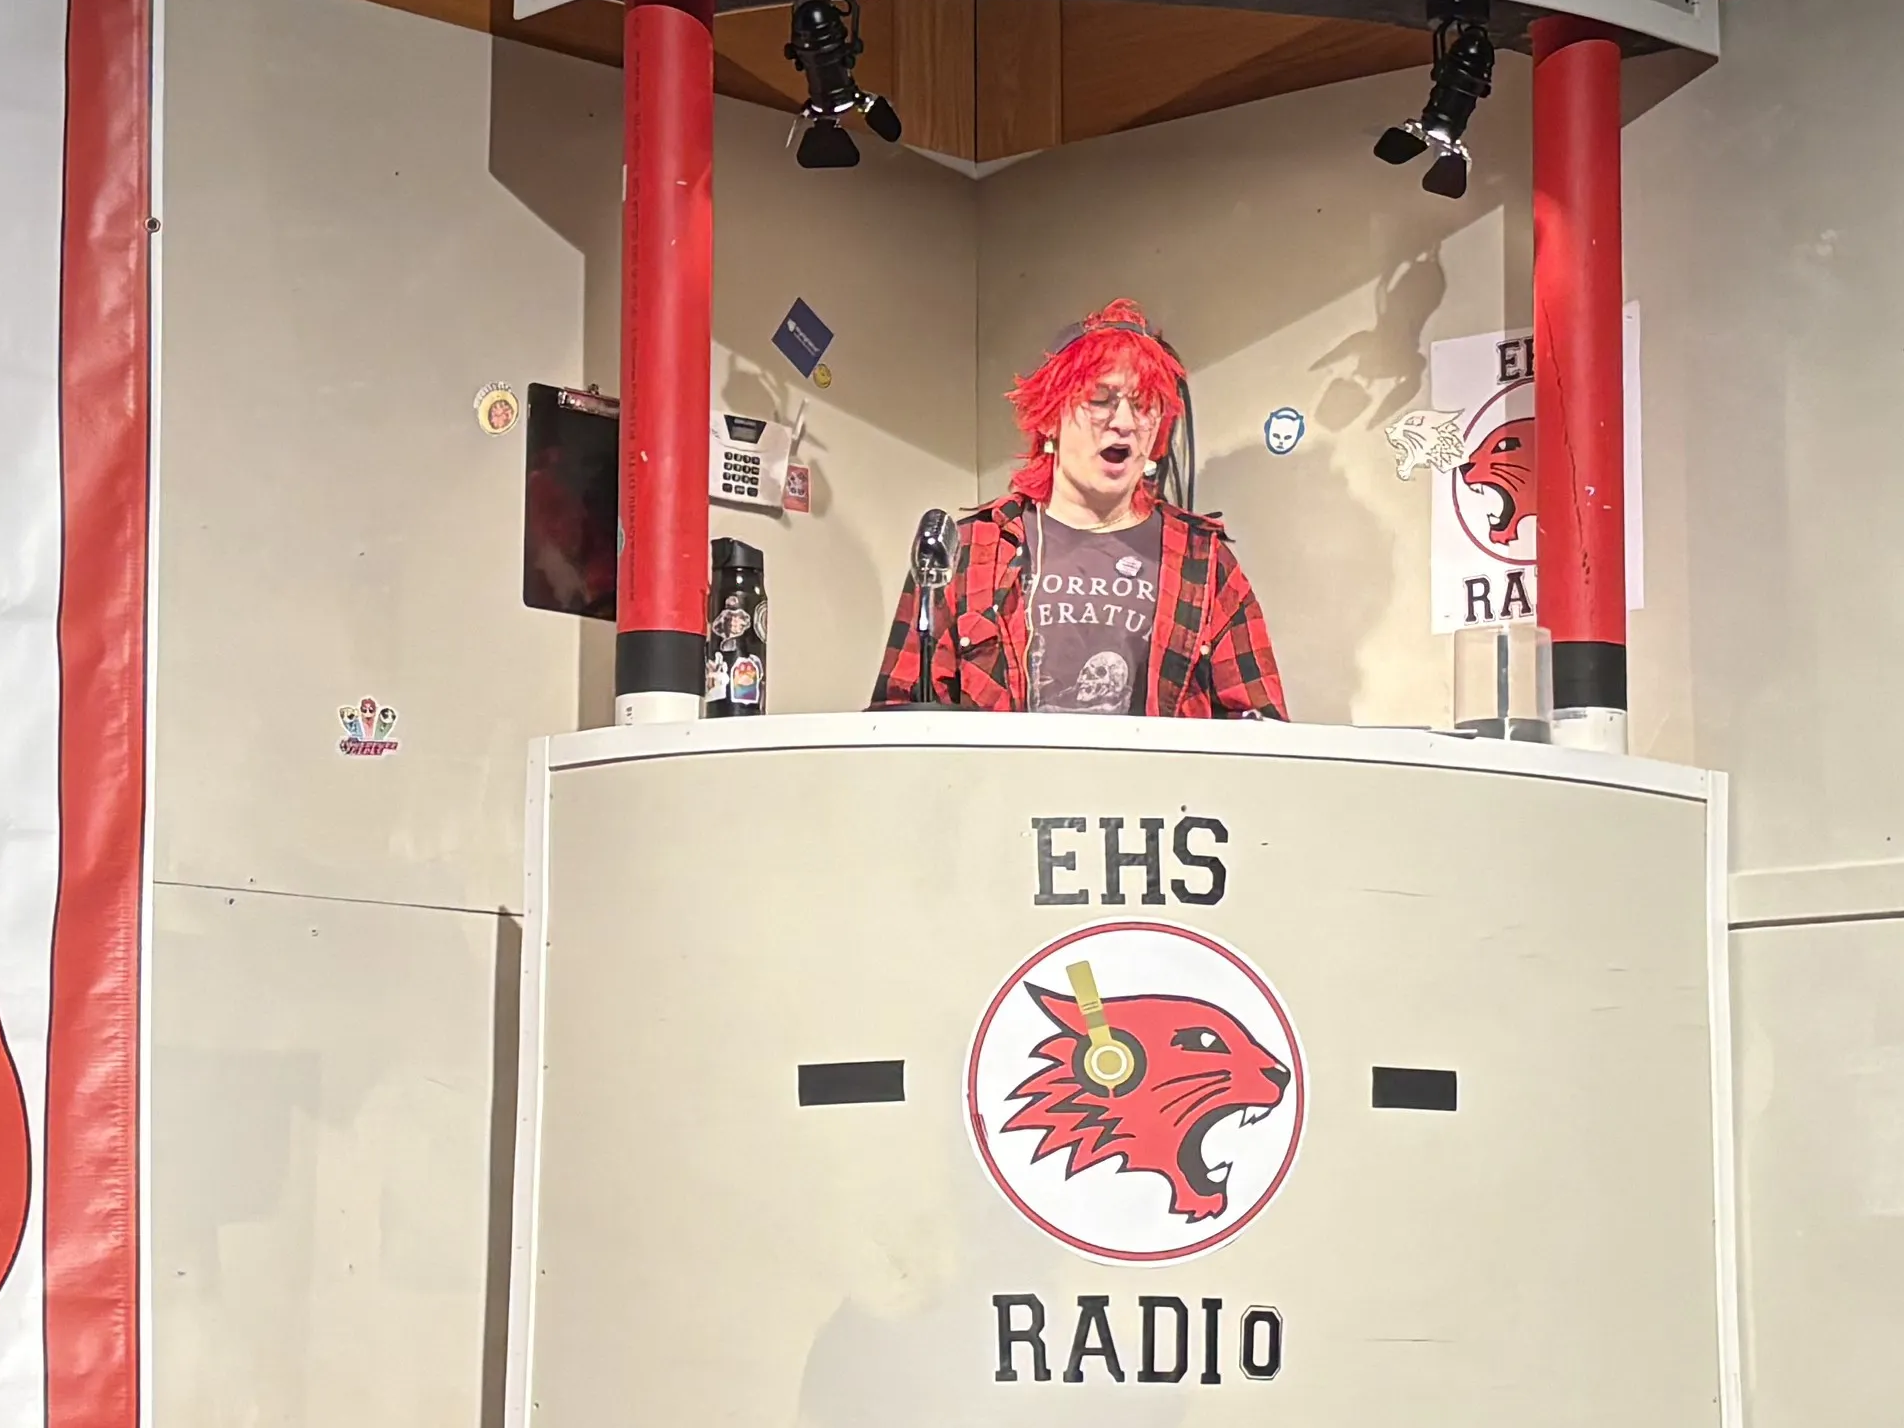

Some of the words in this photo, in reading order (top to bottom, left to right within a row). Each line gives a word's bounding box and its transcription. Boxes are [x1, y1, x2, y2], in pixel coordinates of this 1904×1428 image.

[1034, 602, 1154, 642] ERATU
[1463, 567, 1537, 625] RA
[1031, 815, 1229, 907] EHS
